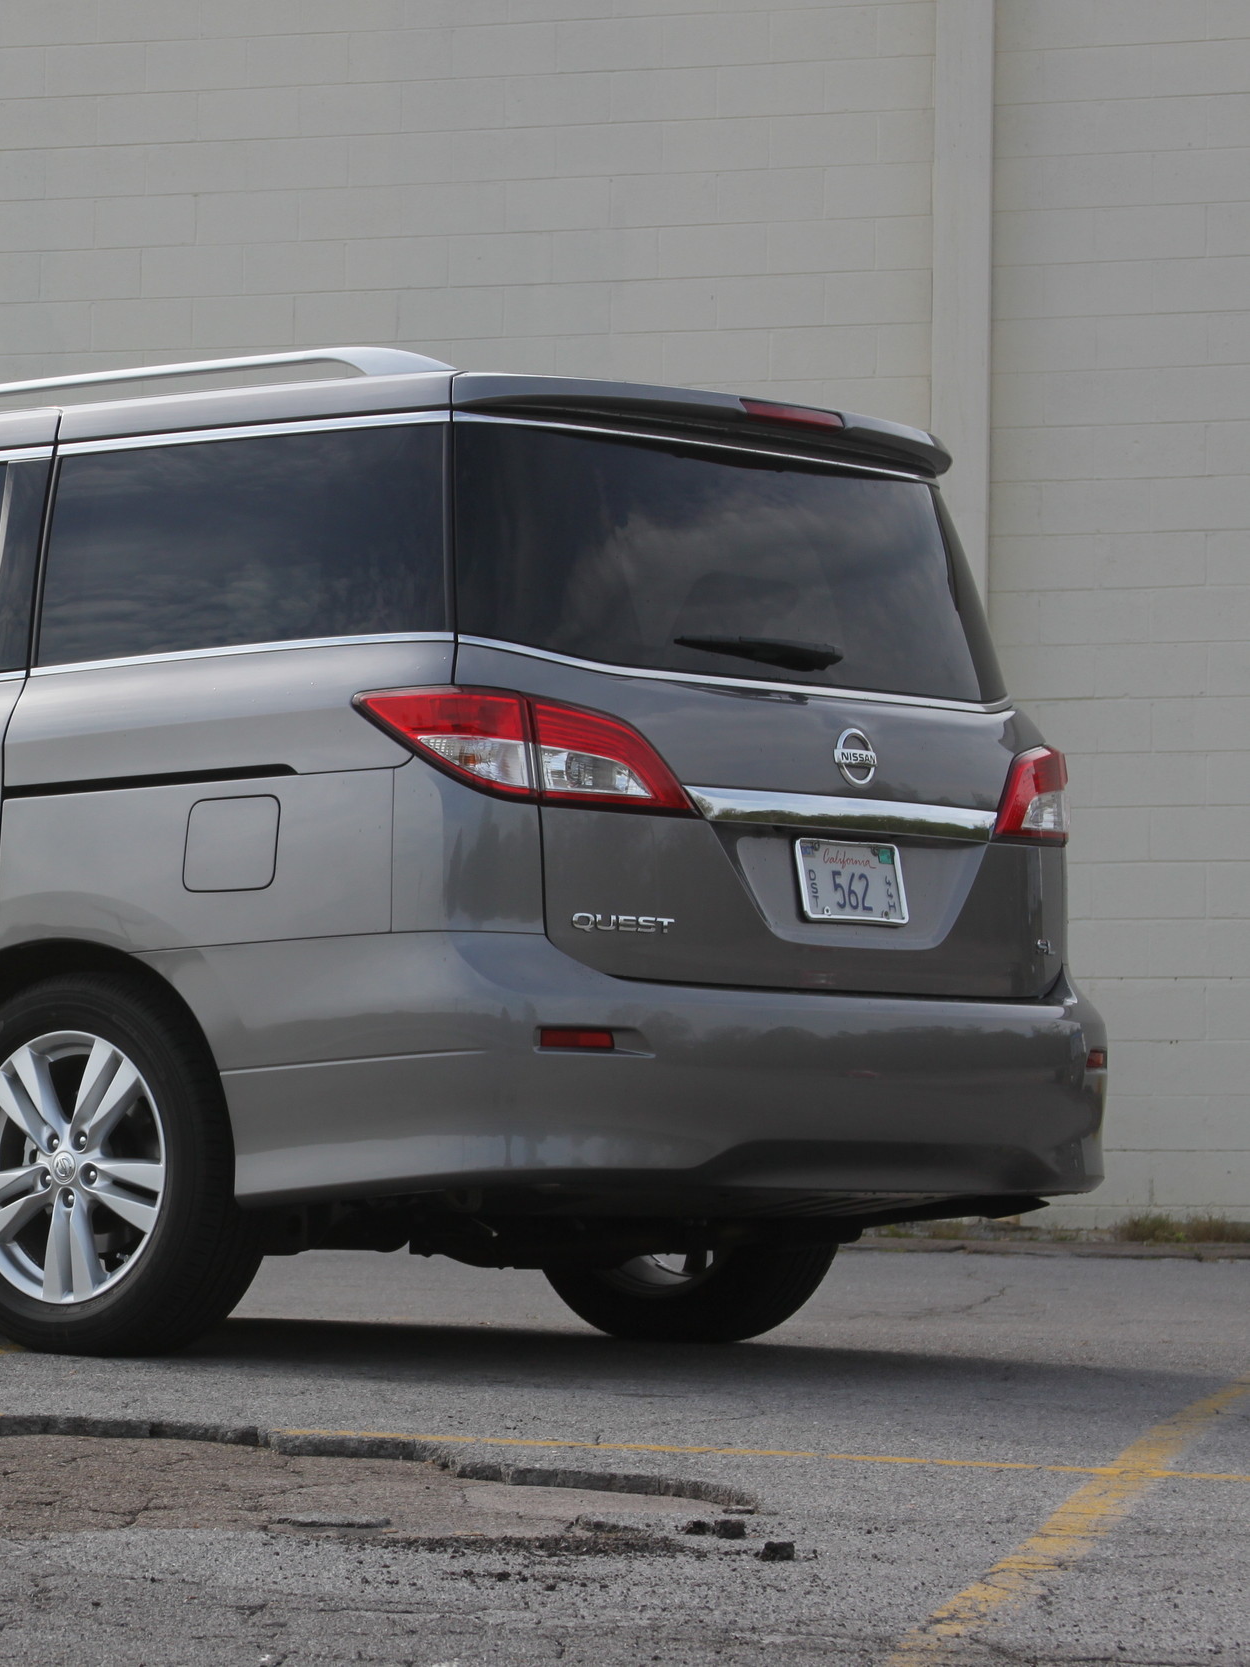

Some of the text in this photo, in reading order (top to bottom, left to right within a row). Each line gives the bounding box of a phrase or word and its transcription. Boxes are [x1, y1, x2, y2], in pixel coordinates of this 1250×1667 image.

[841, 751, 876, 764] NISSAN
[823, 848, 876, 869] California
[831, 870, 873, 911] 562
[572, 912, 675, 933] QUEST
